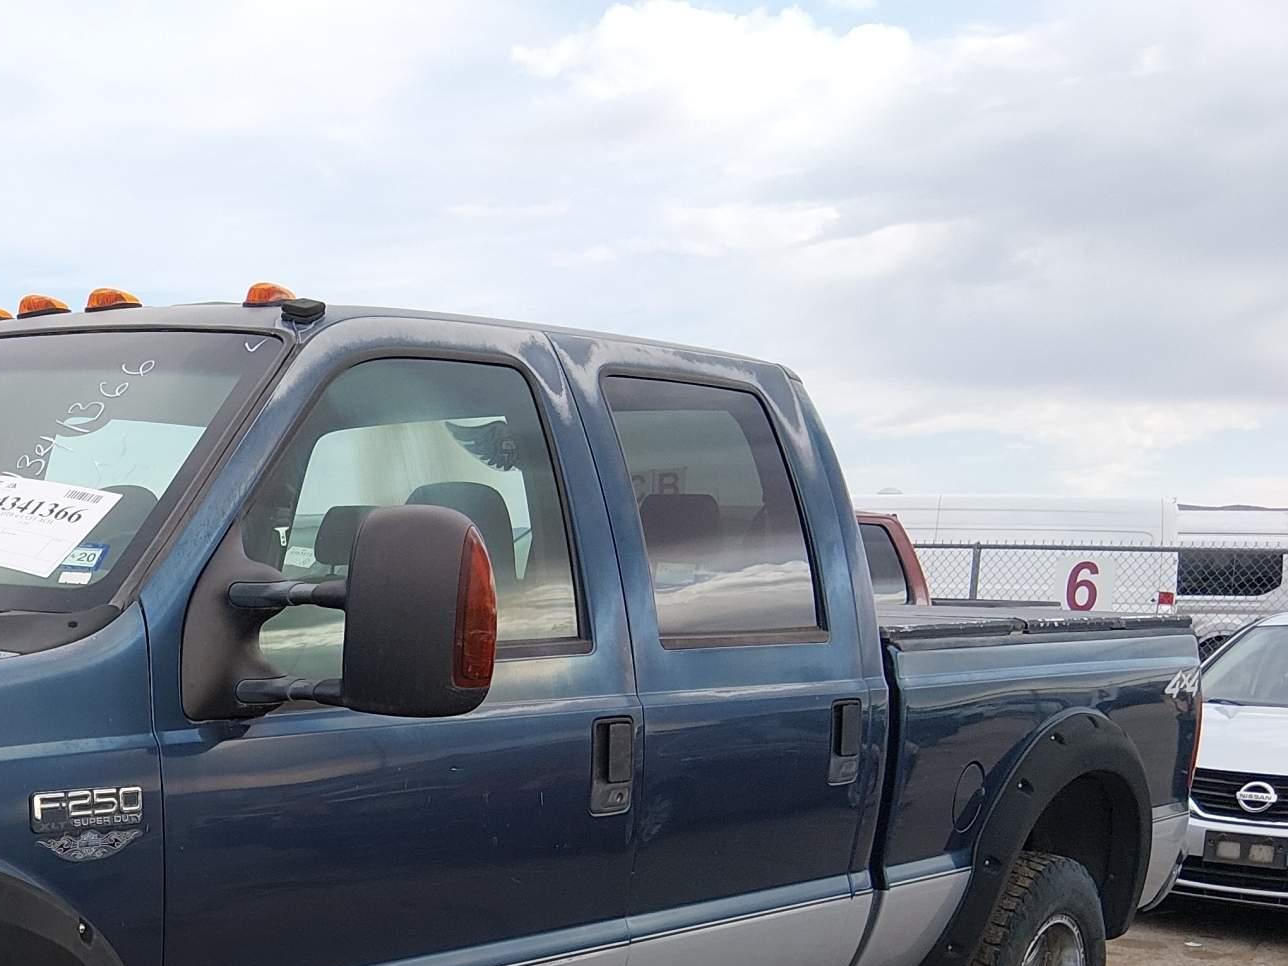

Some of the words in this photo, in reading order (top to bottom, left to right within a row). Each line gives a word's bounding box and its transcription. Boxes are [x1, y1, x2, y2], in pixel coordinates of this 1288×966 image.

[77, 551, 97, 564] 20
[1066, 561, 1099, 611] 6
[33, 786, 143, 821] F-250
[1239, 792, 1273, 801] NISSAN
[73, 816, 111, 827] SUPER
[114, 813, 143, 824] DUTY
